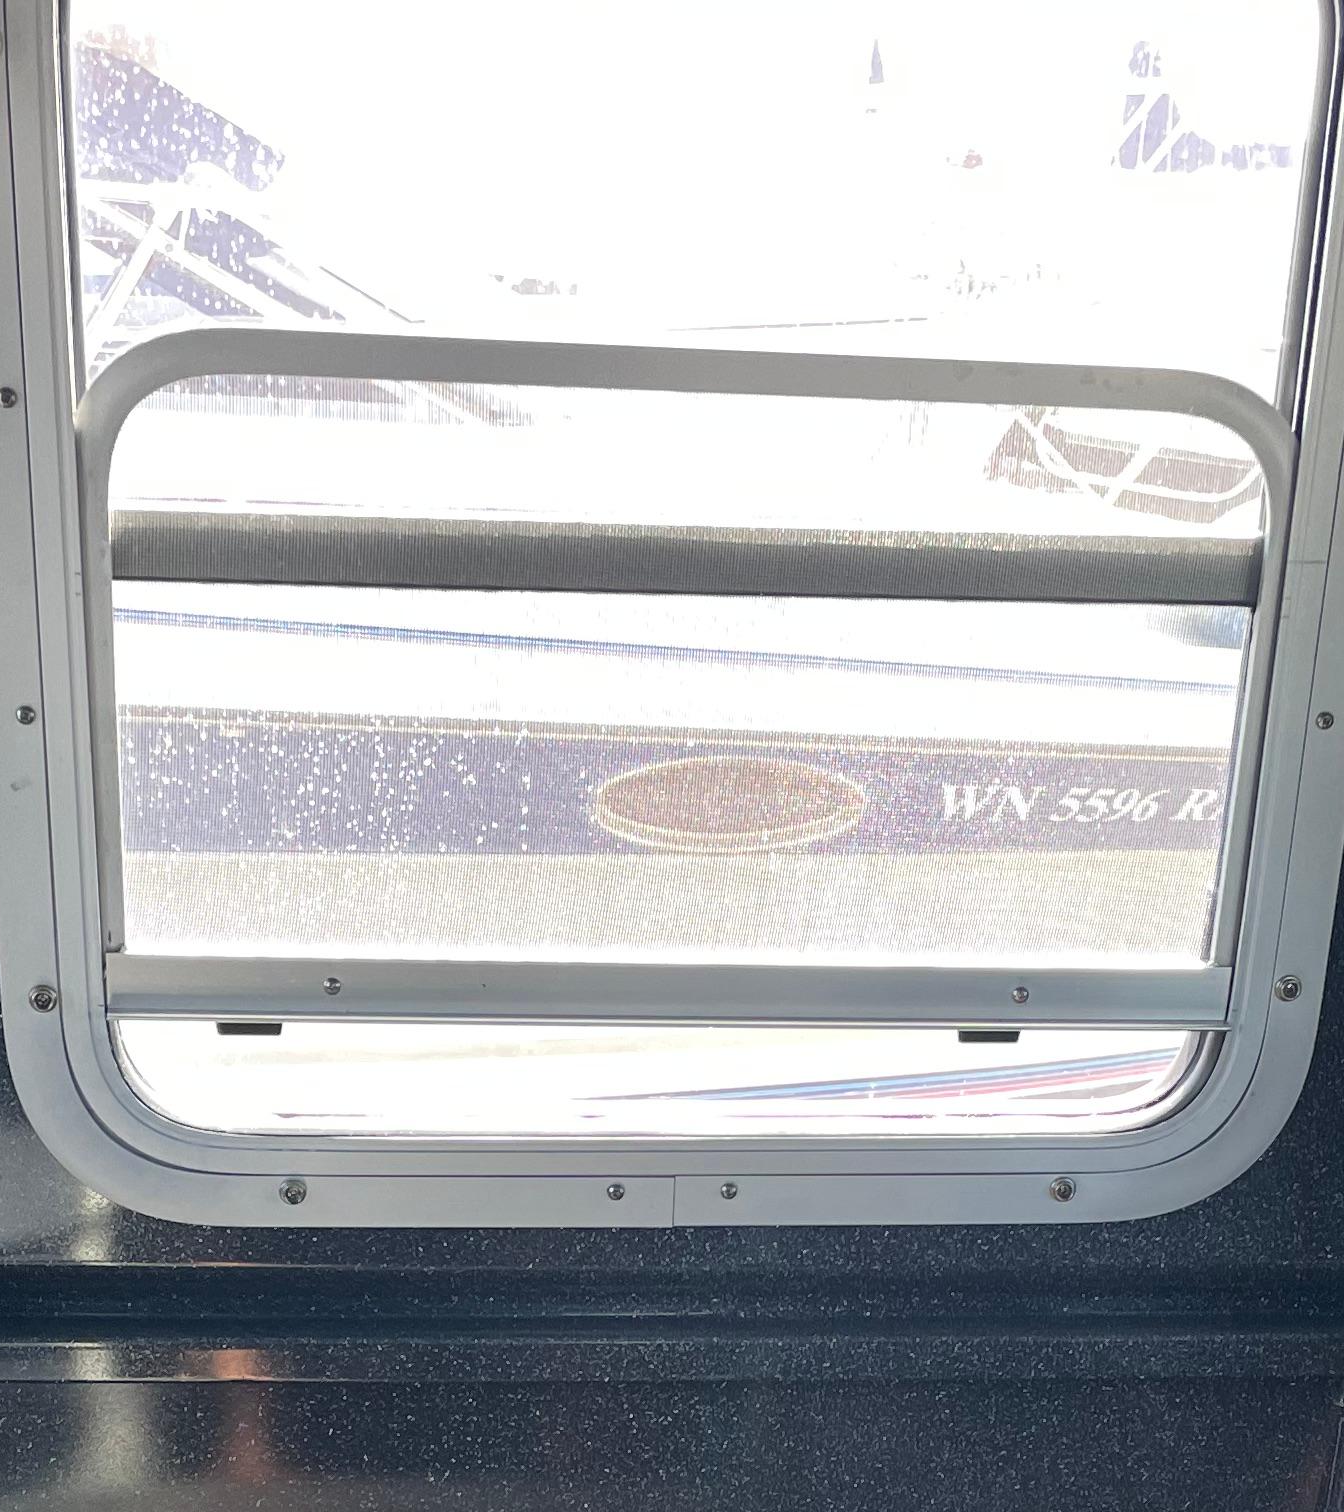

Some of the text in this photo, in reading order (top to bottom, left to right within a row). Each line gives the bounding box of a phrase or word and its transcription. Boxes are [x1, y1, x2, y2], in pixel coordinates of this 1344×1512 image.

[941, 782, 1222, 823] WN 5596 R
